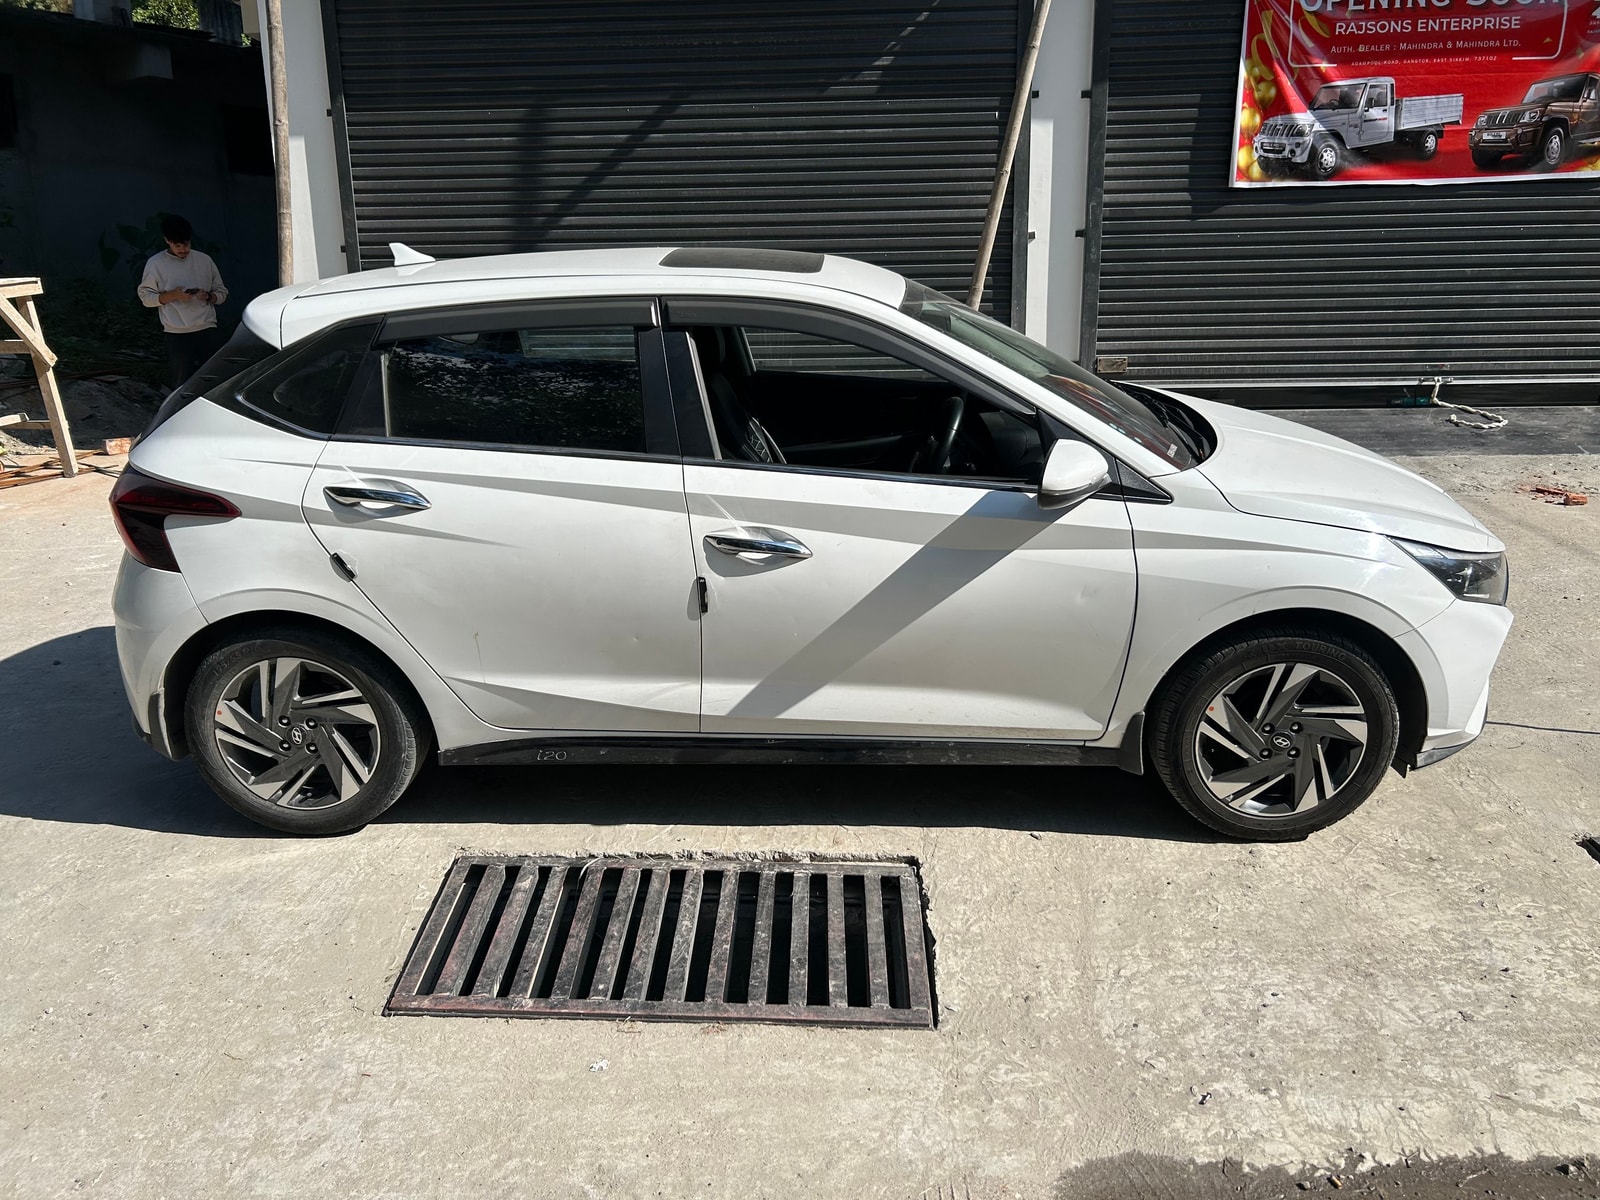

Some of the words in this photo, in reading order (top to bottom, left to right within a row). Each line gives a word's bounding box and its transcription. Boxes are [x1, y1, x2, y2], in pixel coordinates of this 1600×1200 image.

[1335, 19, 1412, 35] RAJSONS
[1417, 16, 1521, 32] ENTERPRISE
[1330, 45, 1356, 54] AUTH.
[1358, 44, 1391, 53] DEALER
[1399, 40, 1444, 50] MAHINDRA
[1446, 40, 1453, 49] &
[1456, 38, 1500, 49] MAHINDRA
[1503, 38, 1521, 47] LTD.
[536, 749, 567, 761] i20
